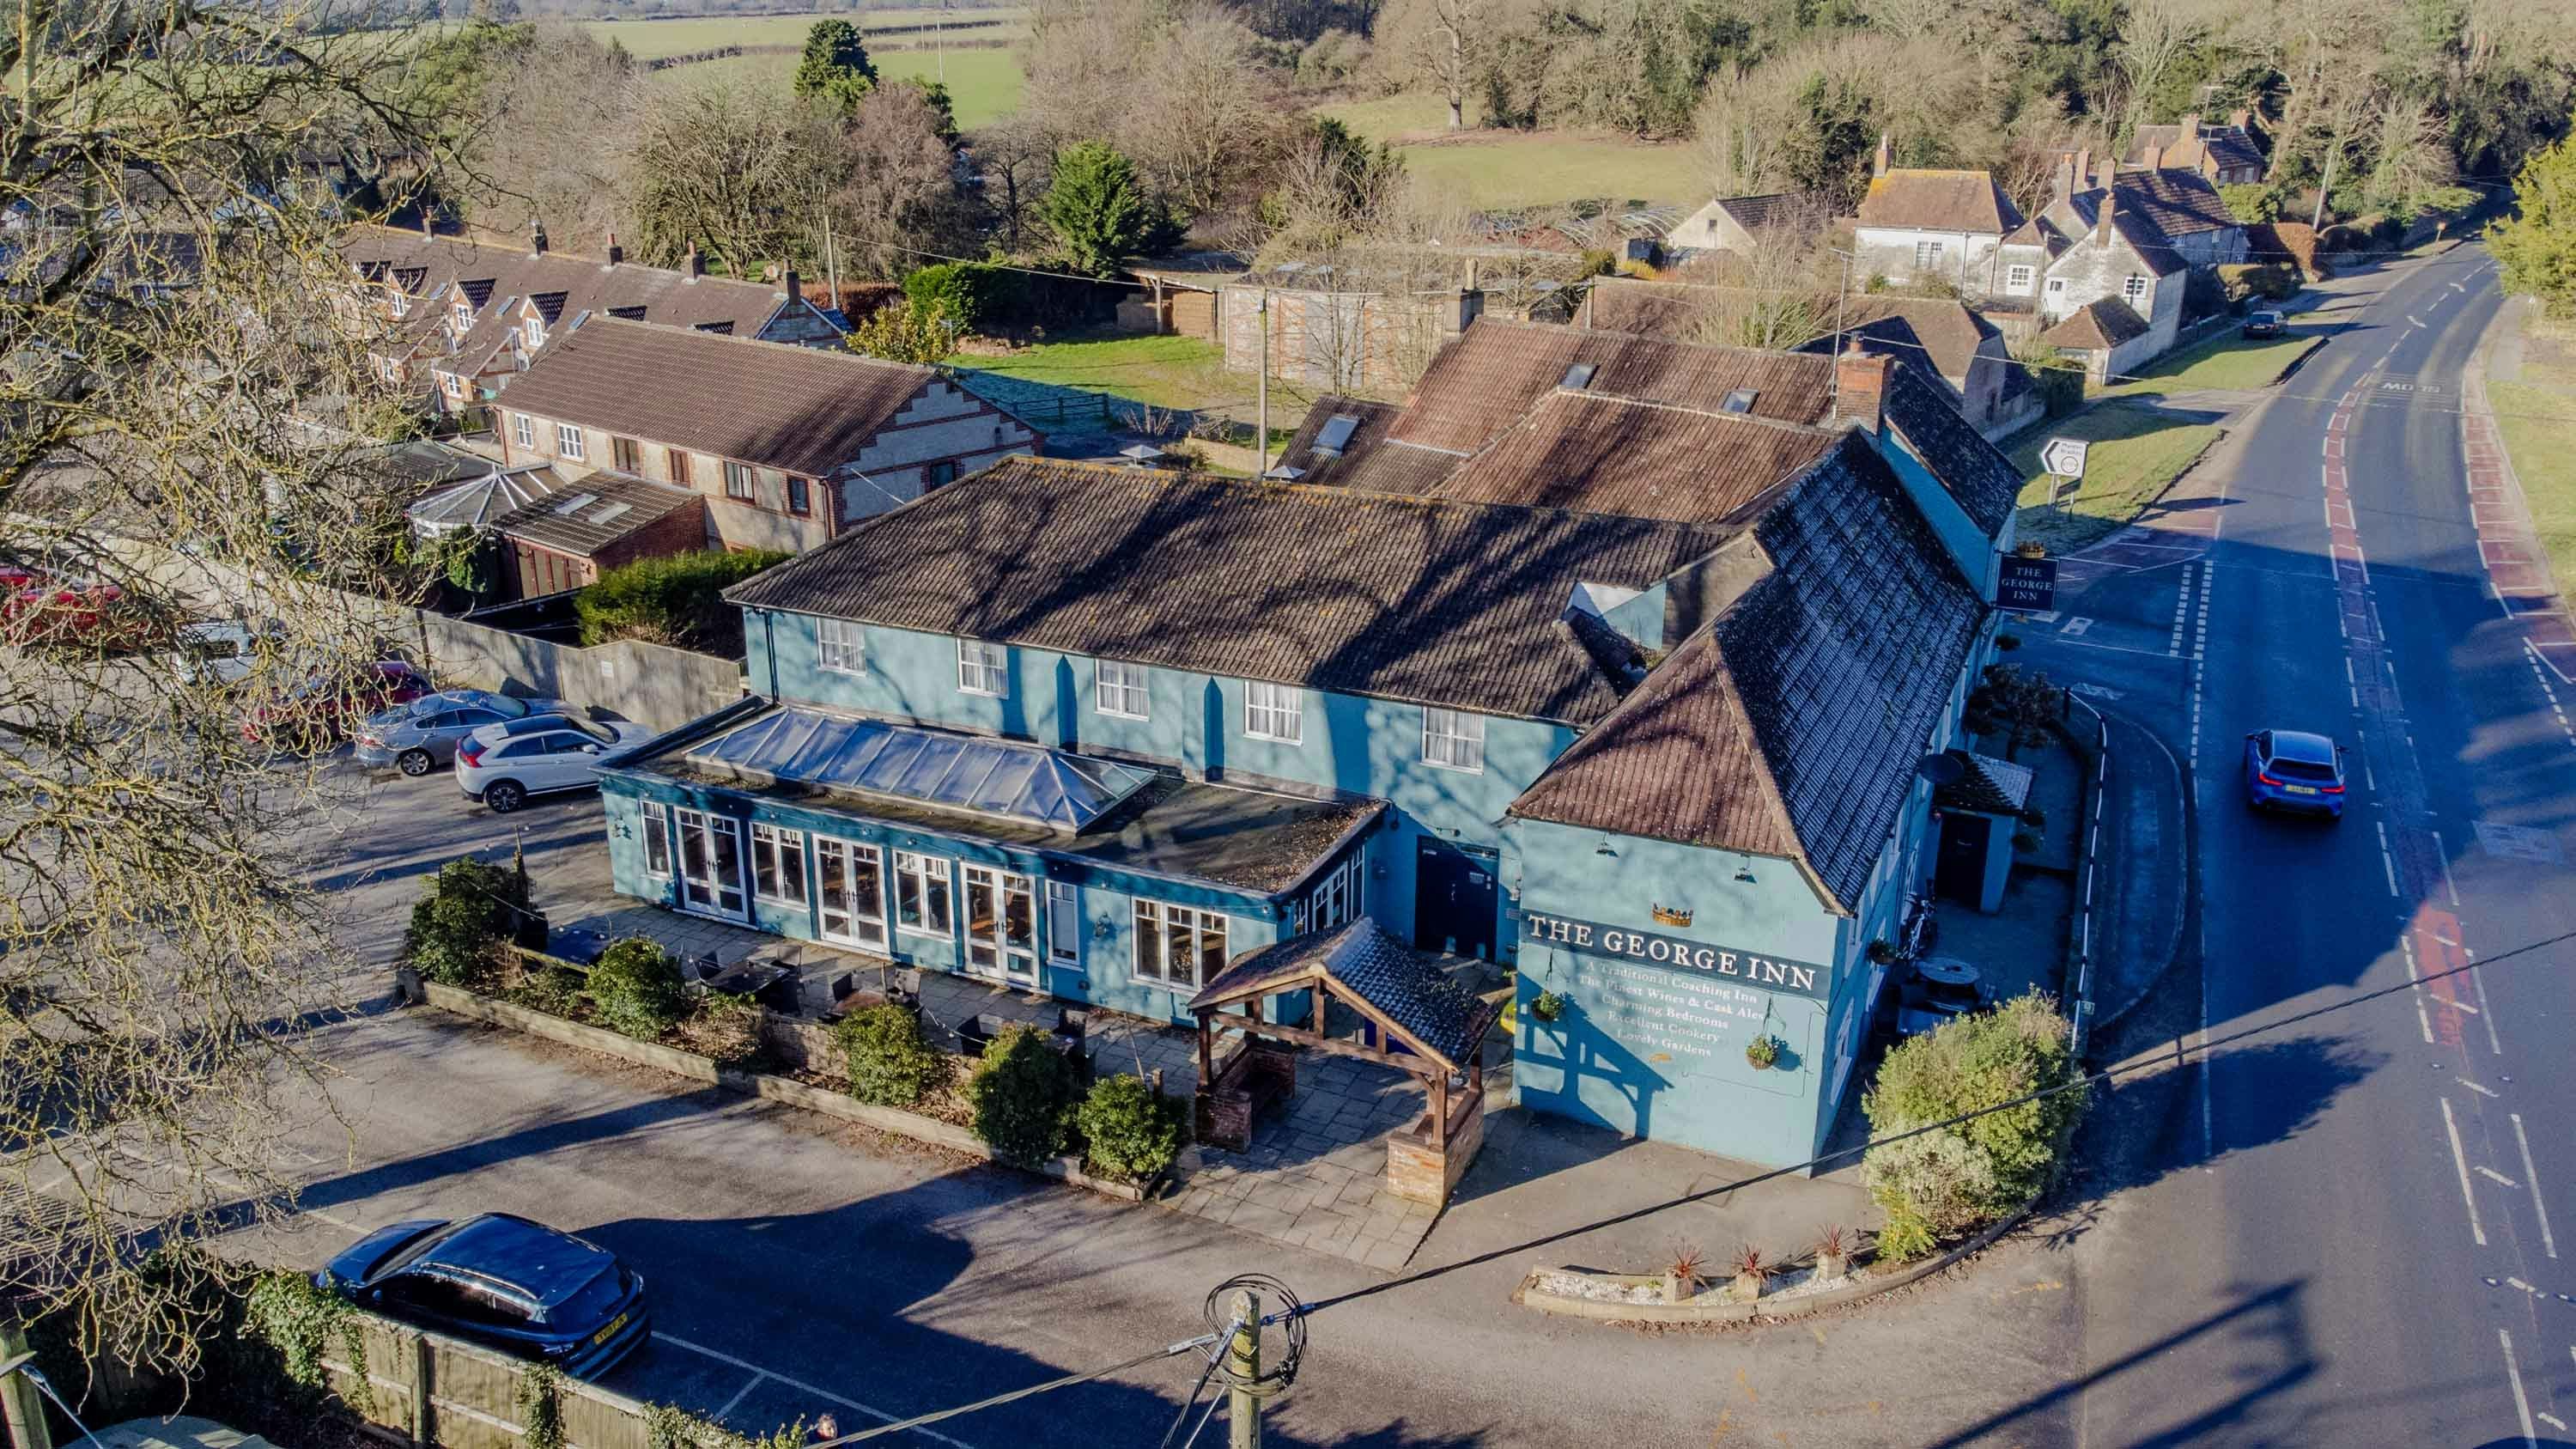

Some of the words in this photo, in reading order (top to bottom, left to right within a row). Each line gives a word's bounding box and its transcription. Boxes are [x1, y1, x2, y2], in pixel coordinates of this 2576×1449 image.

[2002, 578, 2053, 591] GEORGE
[2016, 567, 2042, 577] THE
[2014, 590, 2038, 600] INN
[1528, 914, 1593, 947] THE
[1604, 930, 1738, 976] GEORGE
[1747, 957, 1816, 991] INN
[1581, 975, 1601, 989] The
[1607, 979, 1643, 996] Finest
[1648, 988, 1685, 1005] Wines
[1688, 996, 1699, 1008] &
[1704, 999, 1733, 1014] Cask
[1737, 1006, 1764, 1020] Ales
[1586, 961, 1595, 971] A
[1600, 962, 1668, 985] Traditional
[1671, 977, 1731, 1001] Coaching
[1735, 989, 1757, 1004] Inn
[1602, 995, 1662, 1018] Charming
[1667, 1007, 1728, 1030] Bedrooms
[1607, 1010, 1663, 1032] Excellent
[1668, 1023, 1720, 1044] Cookery
[1617, 1030, 1656, 1046] Lovely
[1662, 1038, 1711, 1058] Gardens
